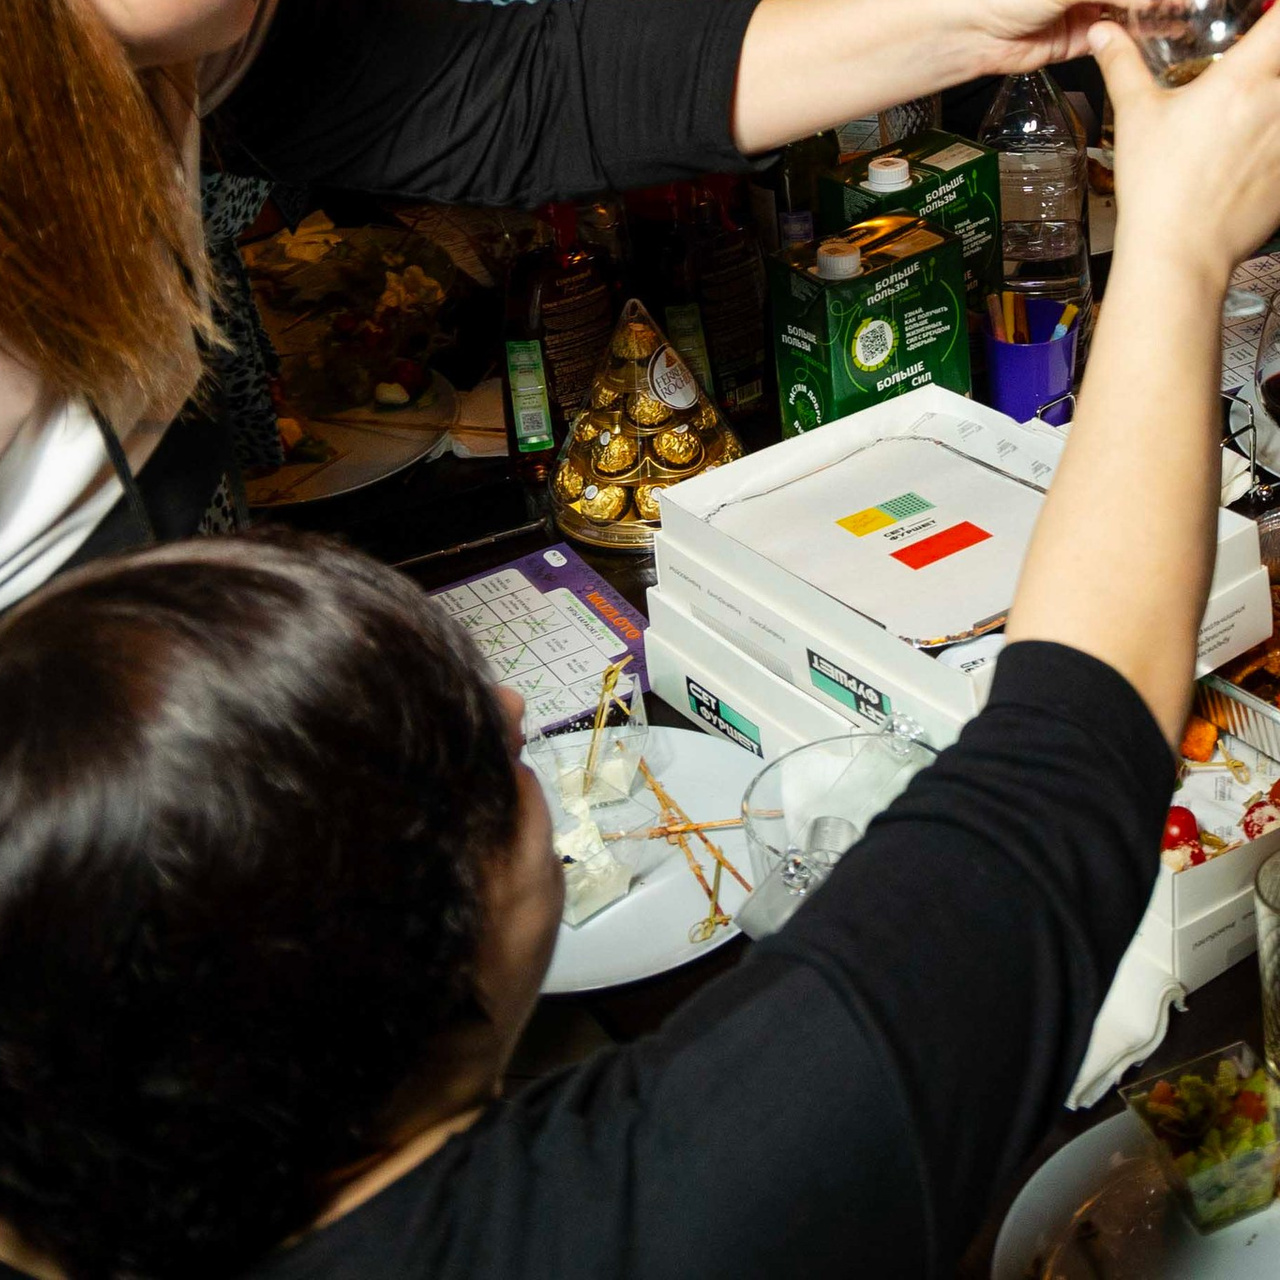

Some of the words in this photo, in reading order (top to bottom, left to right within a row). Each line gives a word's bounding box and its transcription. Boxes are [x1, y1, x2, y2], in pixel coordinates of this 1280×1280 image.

[925, 173, 965, 203] БОЛЬШЕ
[918, 190, 957, 217] ПОЛЬЗЫ
[874, 261, 921, 292] БОЛЬШЕ
[866, 278, 909, 306] ПОЛЬЗЫ
[904, 317, 916, 325] КАК
[917, 306, 948, 320] ПОЛУЧИТЬ
[905, 319, 928, 331] БОЛЬШЕ
[781, 334, 812, 352] ПОЛЬЗЫ
[787, 324, 817, 345] БОЛЬШЕ
[876, 361, 925, 392] БОЛЬШЕ
[911, 371, 932, 387] СИЛ
[883, 527, 906, 538] СЕТ
[889, 519, 937, 541] ФУРШЕТ
[576, 613, 600, 636] КАРАОКЕ
[585, 591, 641, 640] MUZLOTO
[960, 657, 986, 669] СЕТ
[812, 655, 880, 705] ФУРШЕТ
[689, 682, 717, 708] СЕТ
[700, 706, 760, 756] ФУРШЕТ
